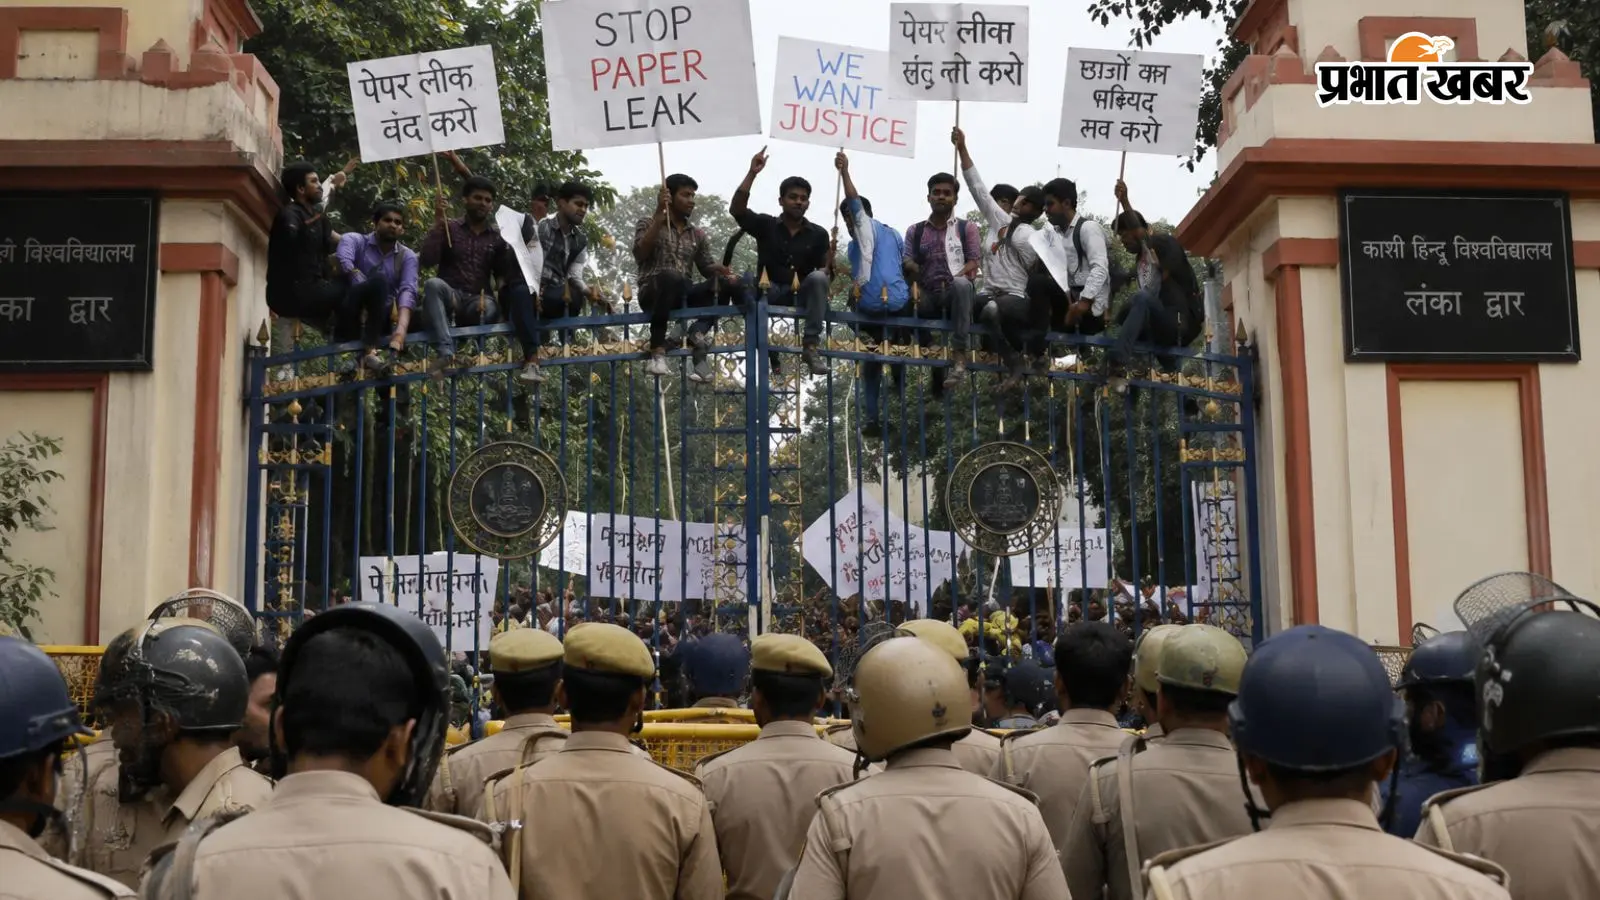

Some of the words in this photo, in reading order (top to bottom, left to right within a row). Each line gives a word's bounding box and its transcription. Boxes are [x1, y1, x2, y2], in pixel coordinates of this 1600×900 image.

[595, 6, 691, 46] STOP
[358, 68, 412, 103] पेपर
[418, 59, 473, 95] लीक
[591, 50, 707, 91] PAPER
[816, 49, 864, 79] WE
[979, 52, 1024, 86] करो
[793, 75, 882, 110] WANT
[429, 98, 477, 137] करो
[603, 92, 701, 131] LEAK
[780, 103, 907, 146] JUSTICE
[1120, 116, 1162, 143] करो
[1361, 235, 1405, 260] काशी
[1412, 236, 1451, 265] हिन्दू
[1453, 236, 1553, 260] विश्वविद्यालय
[68, 296, 112, 324] द्वार
[1404, 283, 1462, 316] लंका
[1484, 291, 1525, 319] द्वार
